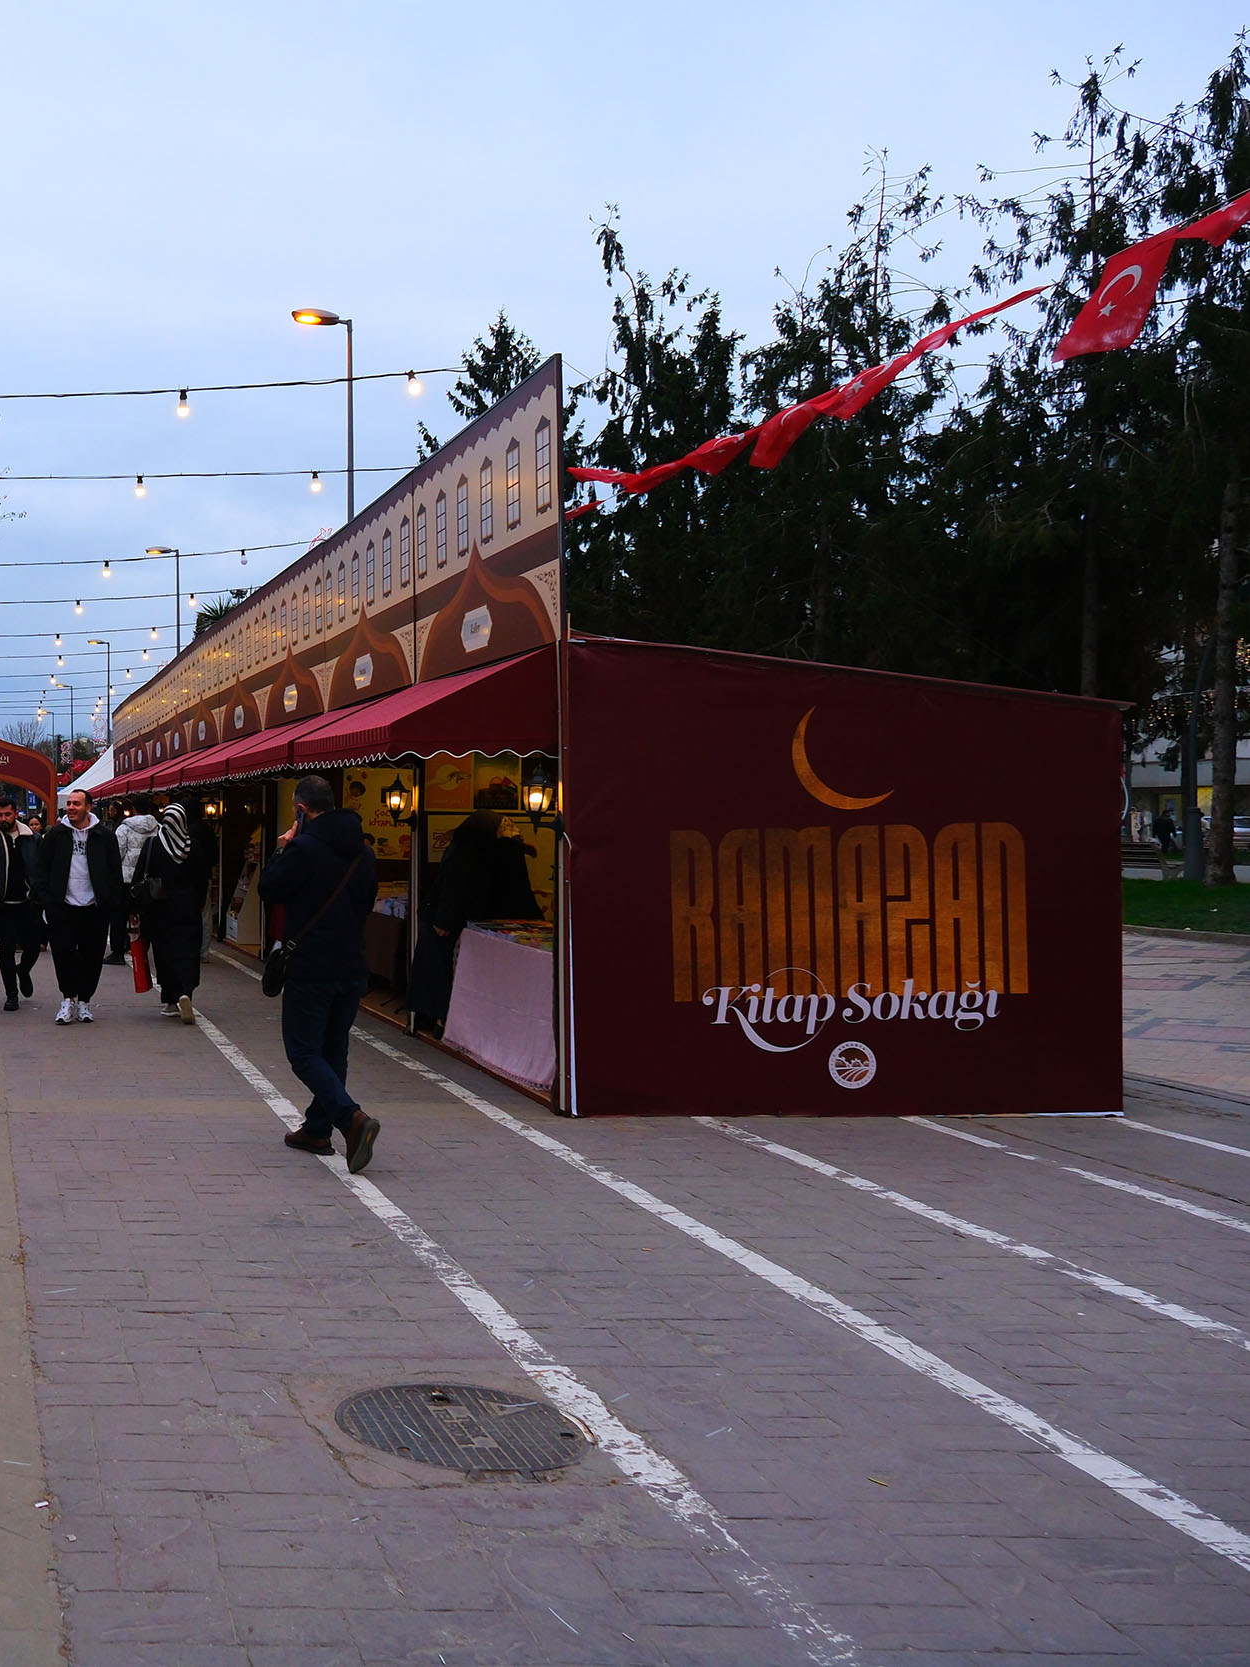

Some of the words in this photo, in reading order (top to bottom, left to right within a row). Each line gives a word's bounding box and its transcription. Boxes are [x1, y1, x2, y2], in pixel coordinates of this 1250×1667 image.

[669, 821, 1030, 1003] RAMAZAN
[701, 967, 837, 1052] Kitap
[841, 978, 1001, 1032] Sokağı
